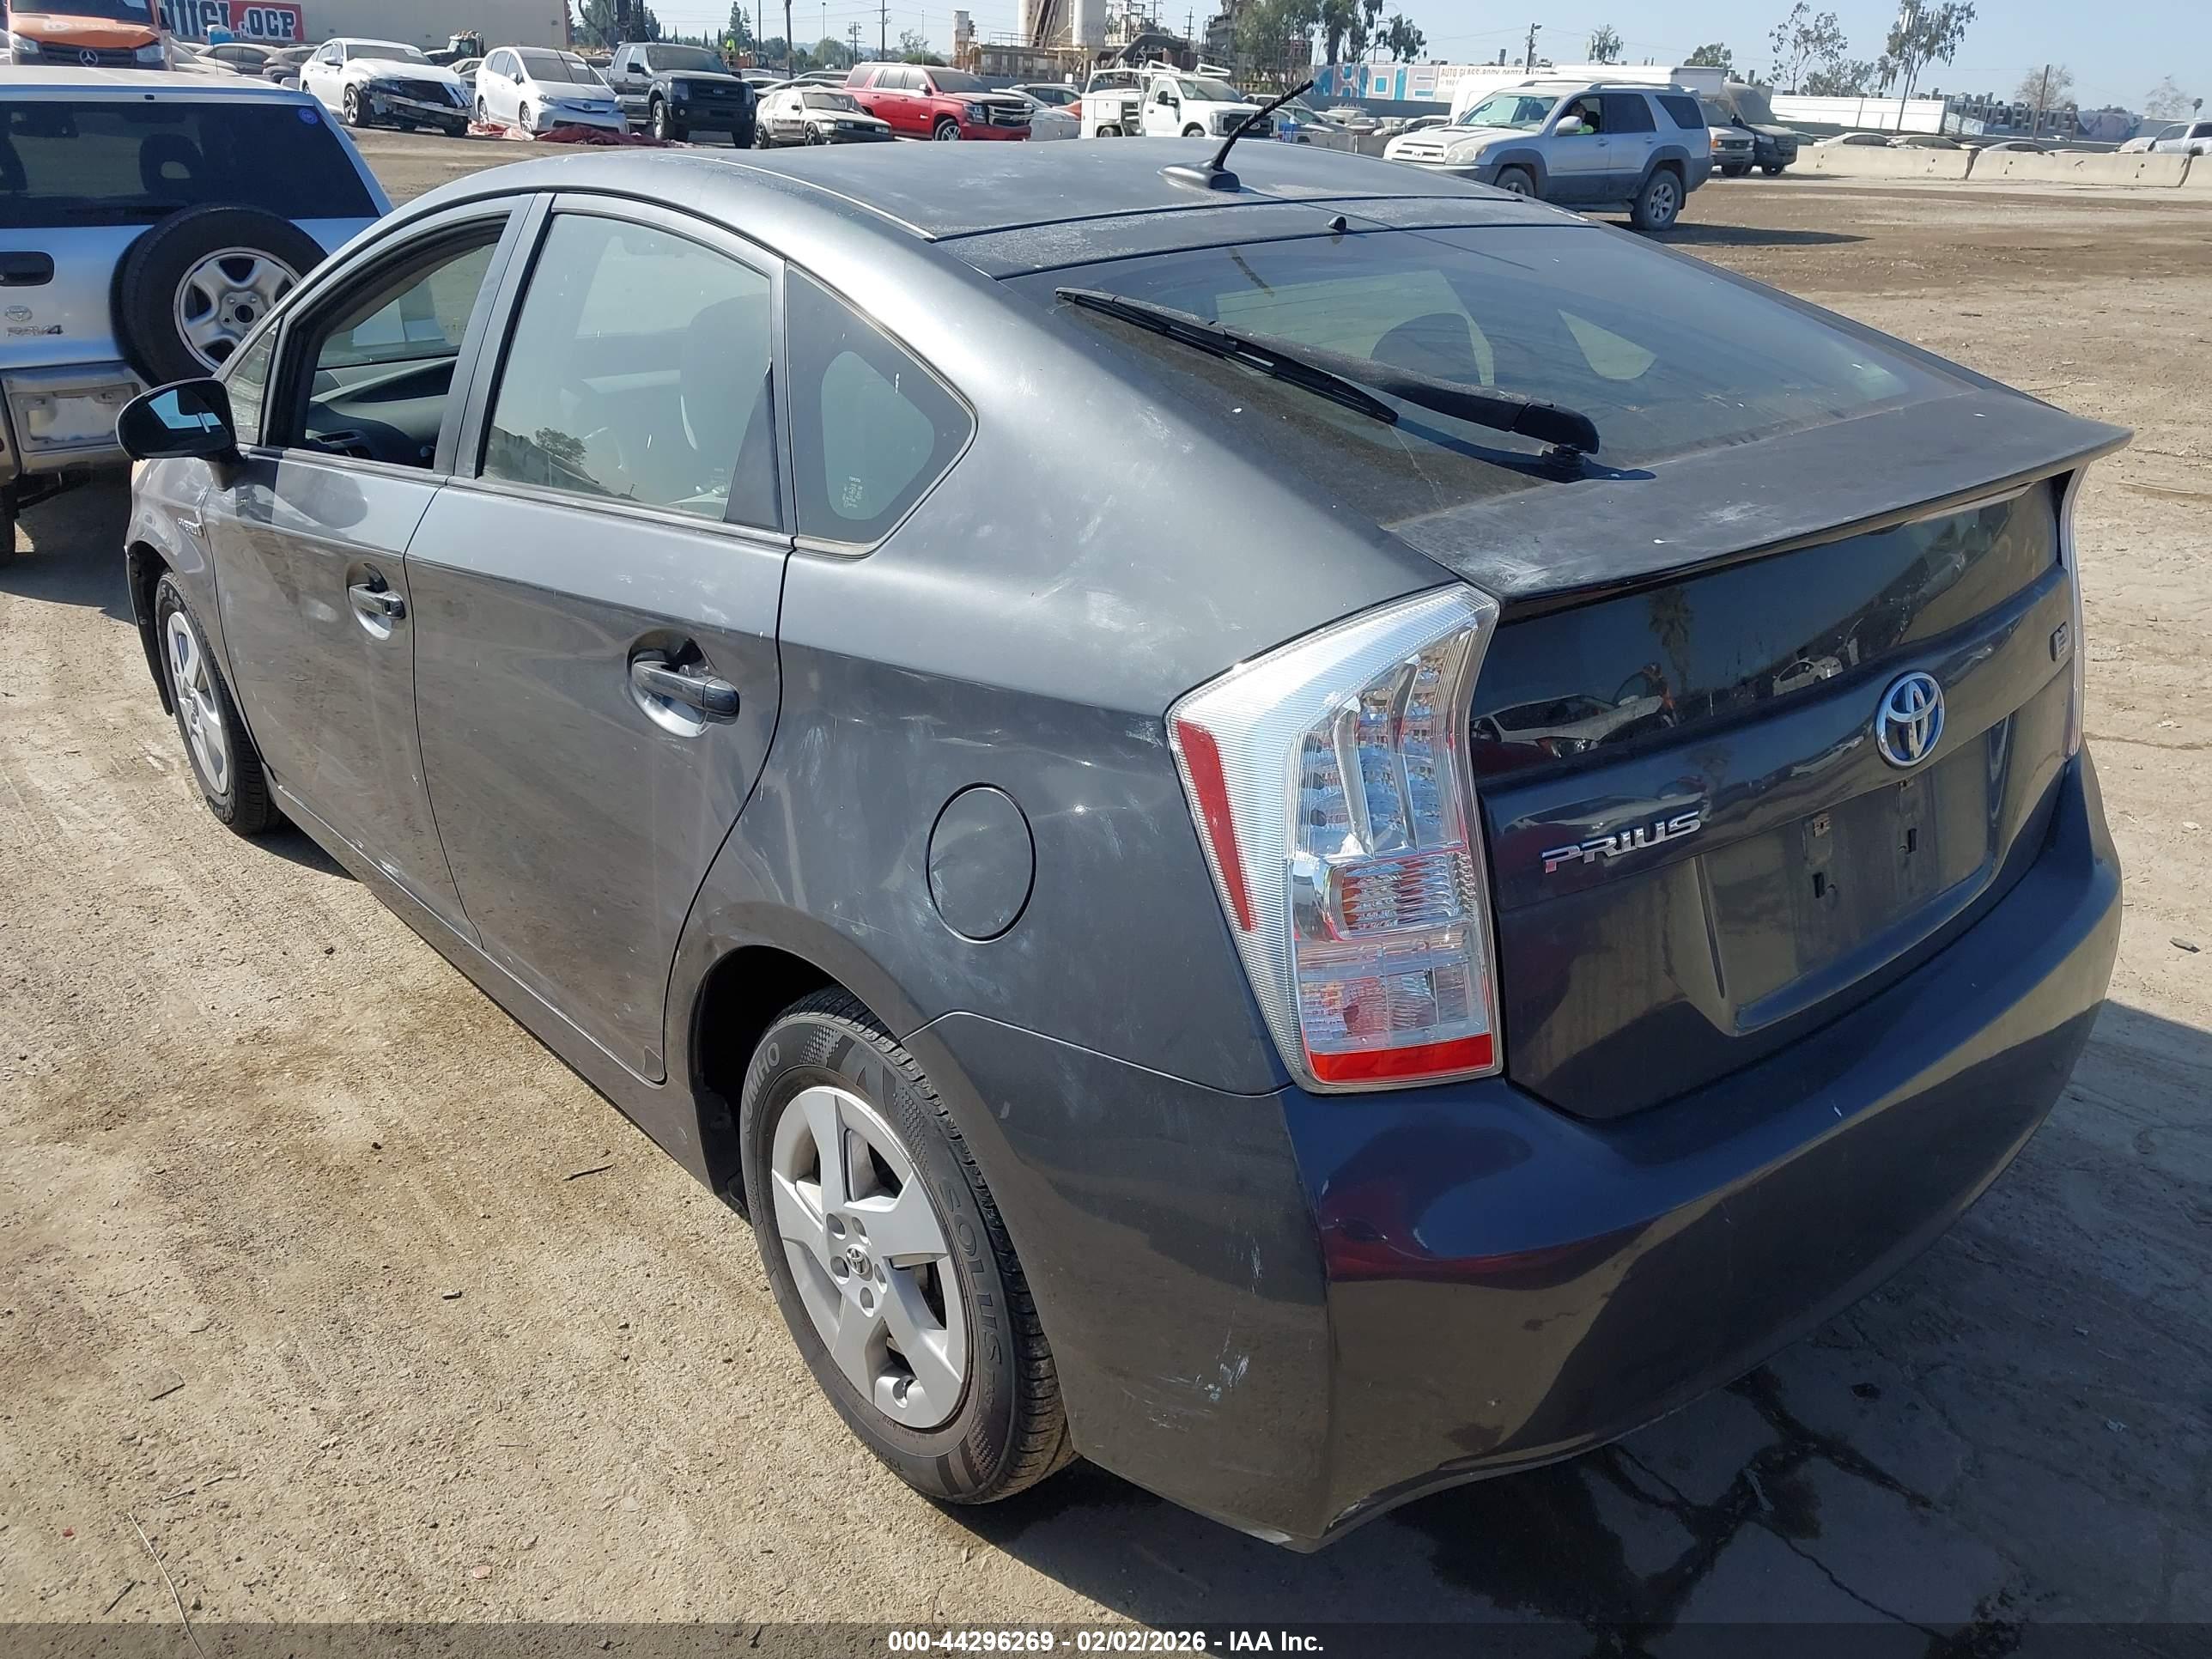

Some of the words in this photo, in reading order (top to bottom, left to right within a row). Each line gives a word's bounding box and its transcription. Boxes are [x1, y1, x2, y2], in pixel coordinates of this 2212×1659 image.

[1441, 68, 1457, 77] AUTO
[1540, 810, 1701, 874] PRIUS
[939, 1183, 1002, 1365] SOLUS
